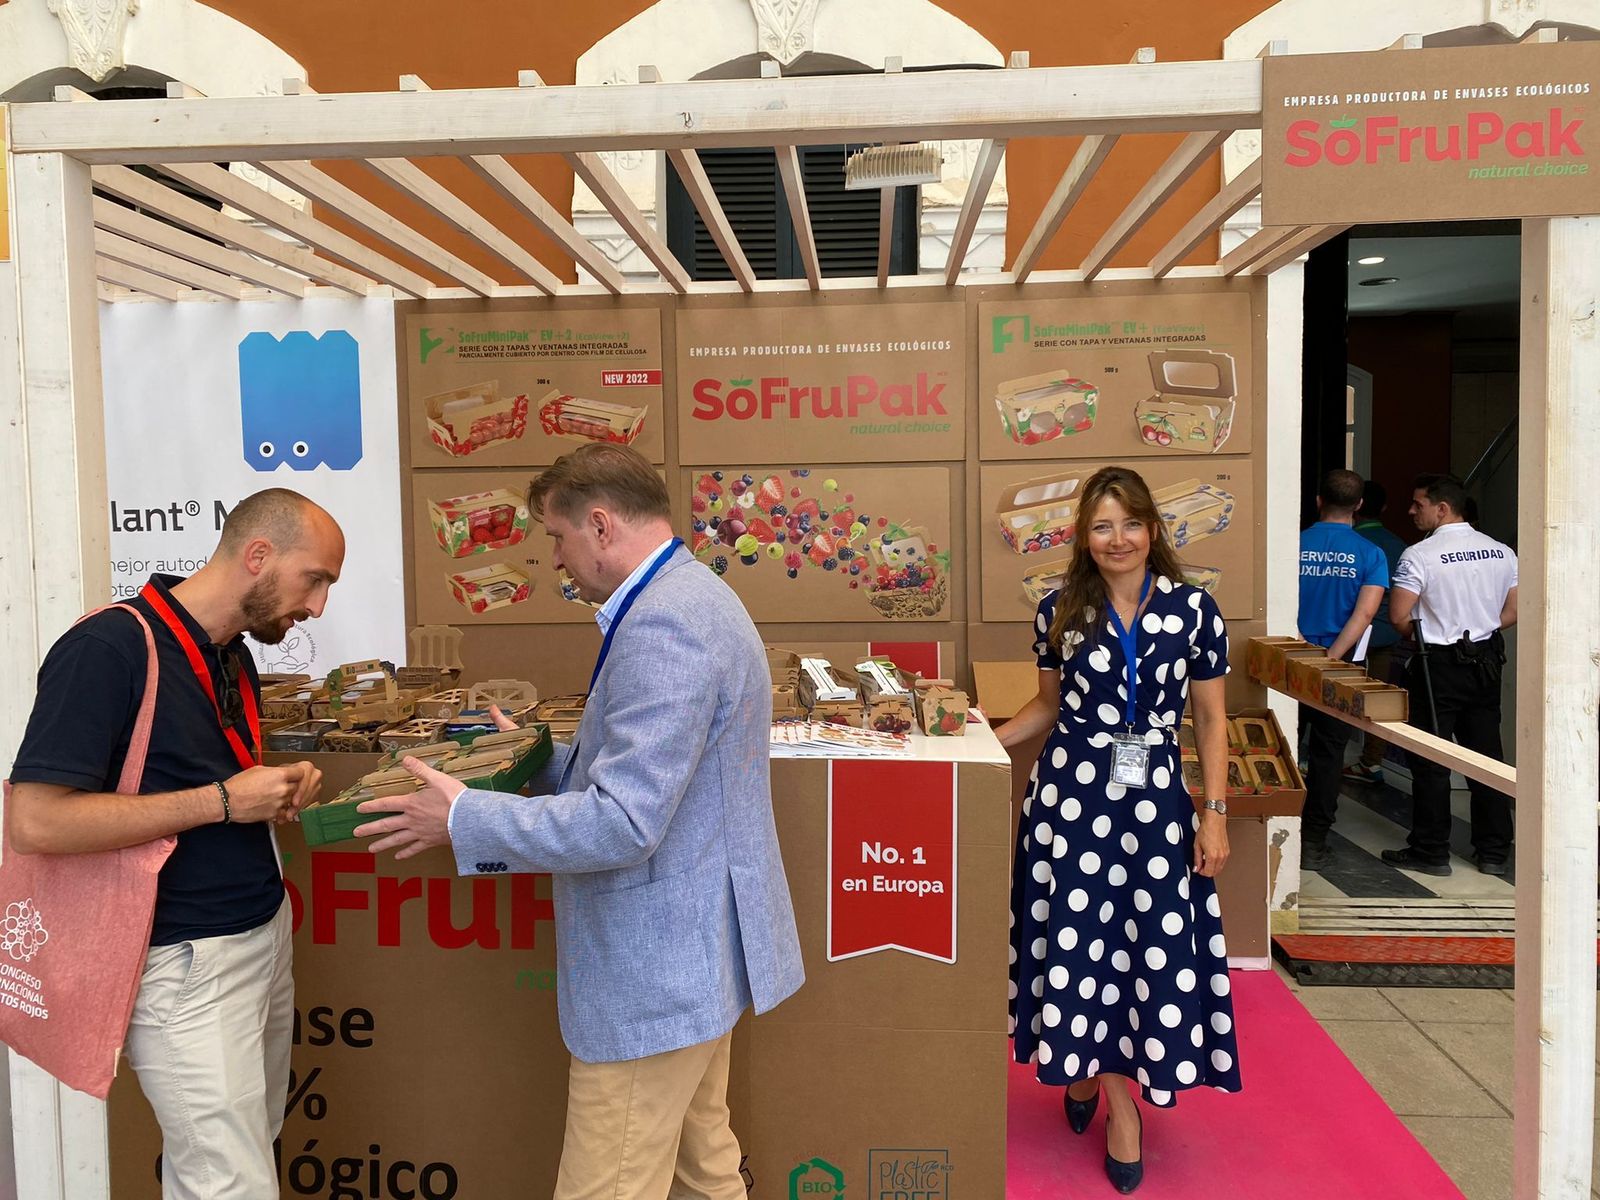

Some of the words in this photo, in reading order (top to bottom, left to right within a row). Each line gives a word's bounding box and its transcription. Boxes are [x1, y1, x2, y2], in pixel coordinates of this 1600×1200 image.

[1283, 95, 1339, 107] EMPRESA
[1346, 90, 1427, 104] PRODUCTORA
[1434, 89, 1448, 100] DE
[1455, 86, 1508, 99] ENVASES
[1516, 82, 1590, 97] ECOLÓGICOS
[1284, 108, 1585, 168] SoFruPak
[1468, 163, 1530, 179] natural
[1533, 161, 1589, 177] choice
[482, 344, 499, 352] CON
[579, 342, 628, 350] INTEGRADAS
[689, 346, 738, 357] EMPRESA
[743, 345, 812, 356] PRODUCTORA
[817, 344, 830, 354] DE
[836, 342, 881, 353] ENVASES
[887, 340, 951, 351] ECOLÓGICOS
[1060, 339, 1077, 347] CON
[1108, 336, 1151, 345] VENTANAS
[1153, 334, 1206, 343] INTEGRADAS
[604, 374, 623, 385] NEW
[626, 373, 648, 384] 2022
[691, 372, 949, 421] SoFruPak
[850, 422, 901, 435] natural
[904, 420, 951, 433] choice
[111, 500, 200, 532] lant®
[1300, 551, 1356, 564] ERVICIOS
[1440, 549, 1504, 564] SEGURIDAD
[1300, 565, 1357, 578] XILARES
[861, 842, 905, 864] No.
[912, 847, 927, 865] 1
[842, 877, 867, 891] en
[873, 876, 944, 897] Europa
[0, 963, 42, 990] ONGRESO
[0, 978, 46, 1006] NACIONAL
[0, 993, 20, 1008] TOS
[20, 1001, 49, 1019] ROJOS
[802, 1182, 832, 1193] BIO
